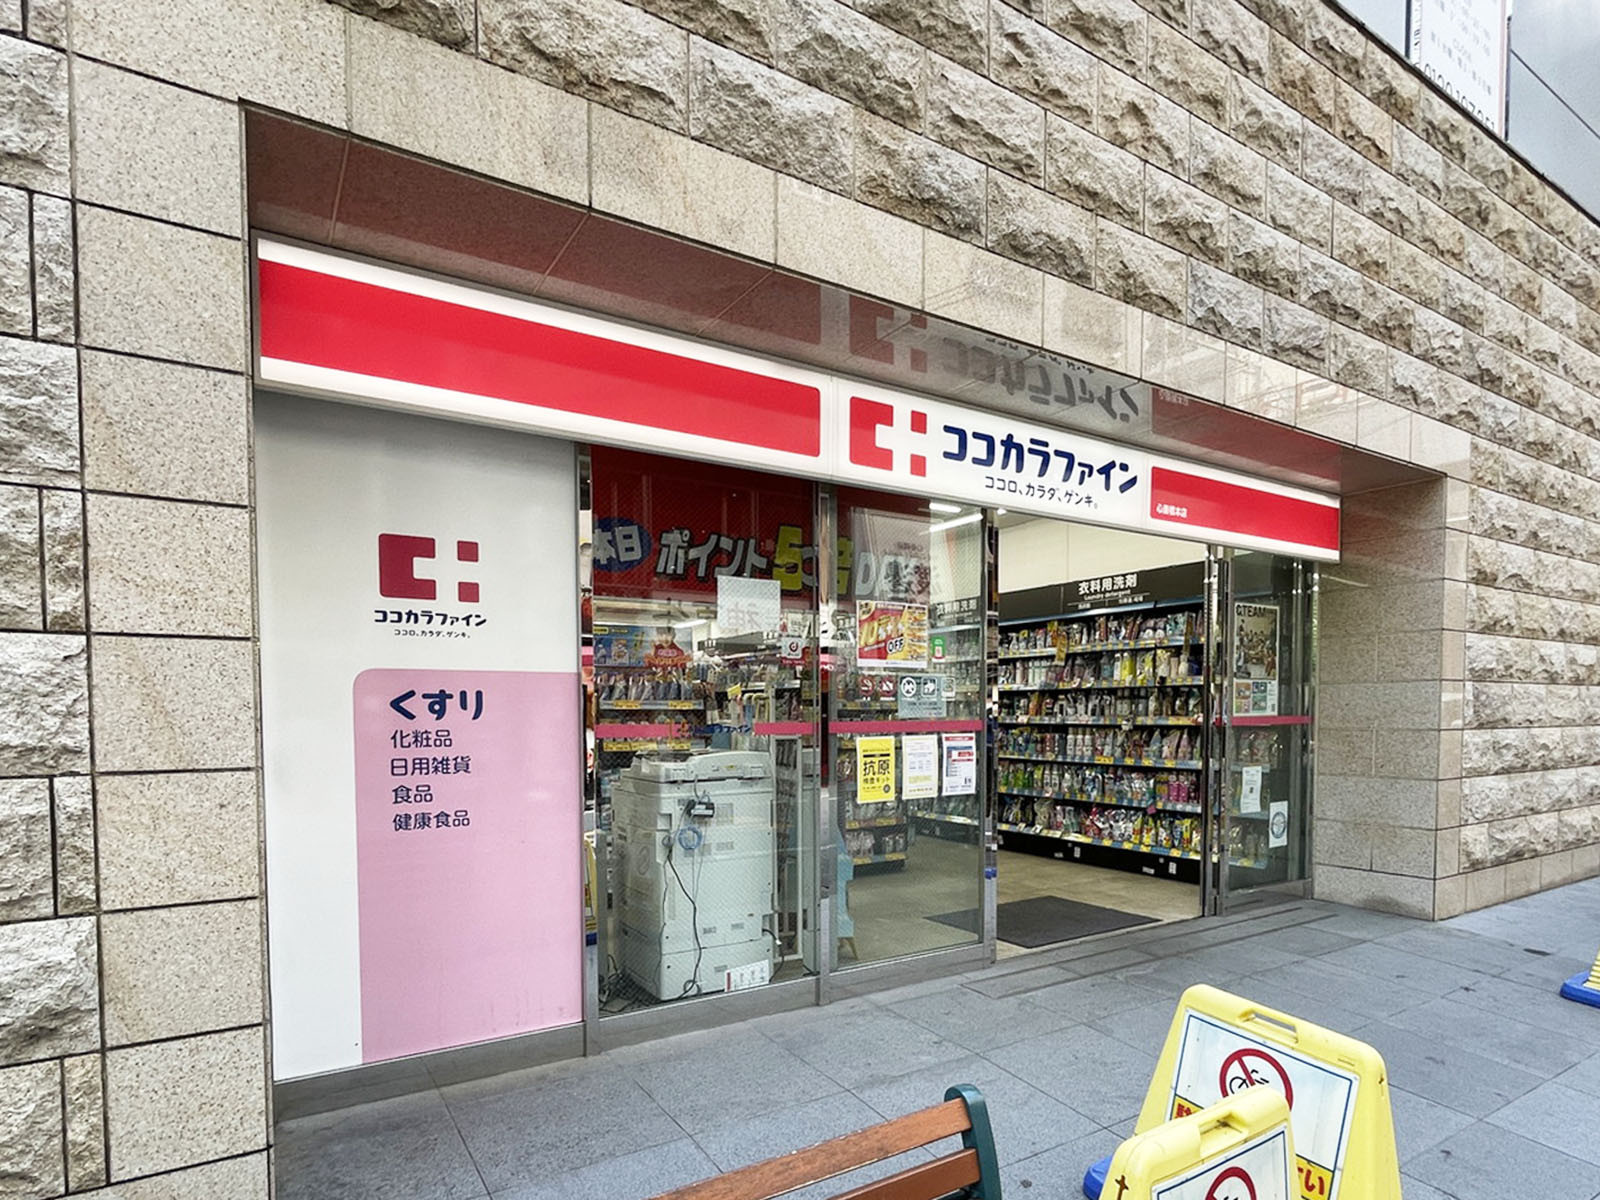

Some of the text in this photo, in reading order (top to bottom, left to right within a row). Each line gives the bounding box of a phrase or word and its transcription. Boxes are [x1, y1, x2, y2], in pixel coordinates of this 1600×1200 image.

[943, 424, 1138, 493] ココカラファイン
[1078, 573, 1138, 596] 衣料用洗剤
[374, 609, 487, 627] ココカラファイン
[887, 638, 904, 653] OFF
[389, 689, 484, 720] くすり
[390, 729, 452, 748] 化粧品
[390, 756, 472, 776] 日用雑貨
[862, 760, 890, 776] 抗原
[392, 785, 433, 804] 食品
[392, 810, 470, 831] 健康食品
[1297, 1167, 1325, 1195] い
